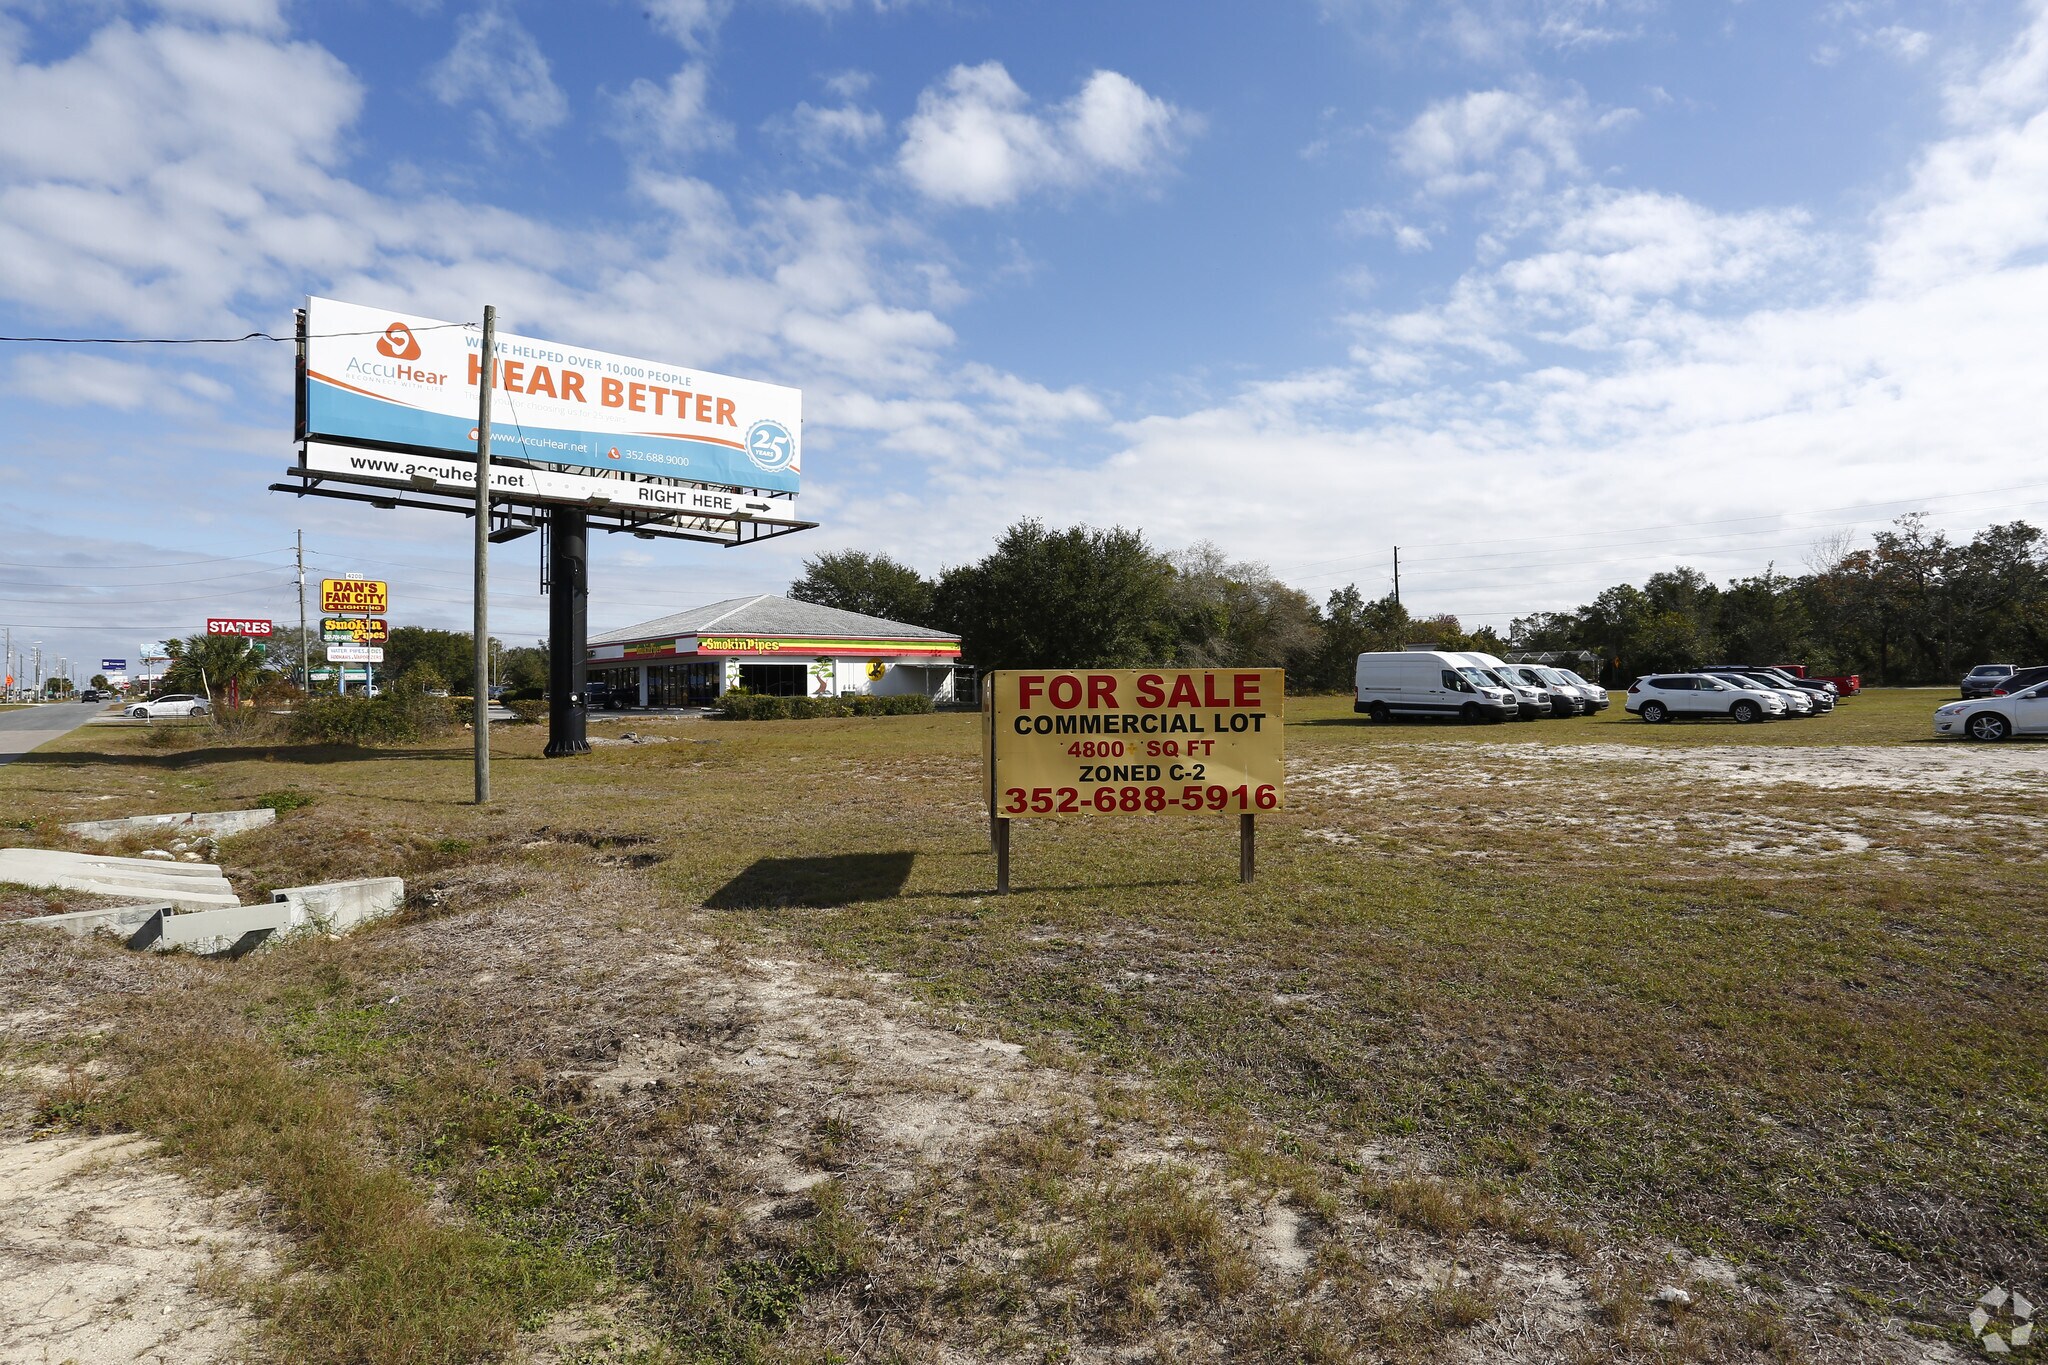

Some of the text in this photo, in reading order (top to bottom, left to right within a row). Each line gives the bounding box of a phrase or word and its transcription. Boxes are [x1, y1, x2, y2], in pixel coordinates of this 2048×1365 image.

[346, 356, 448, 386] AccuHear
[513, 344, 564, 363] HELPED
[568, 355, 602, 371] OVER
[606, 362, 645, 379] 10,000
[648, 370, 692, 387] PEOPLE
[467, 353, 738, 427] HEAR BETTER
[752, 429, 788, 463] 25
[755, 449, 774, 457] YEARS
[625, 448, 690, 467] 352.688.9000
[638, 487, 686, 504] RIGHT
[693, 493, 733, 510] HERE
[333, 581, 378, 593] DAN'S
[325, 592, 385, 604] FAN CITY
[209, 621, 270, 634] STAPLES
[325, 619, 383, 631] Smokin
[353, 629, 386, 641] Pipes
[1018, 673, 1262, 710] FOR SALE
[1014, 712, 1266, 735] COMMERCIAL LOT
[1067, 739, 1215, 758] 4800 SQ FT
[1079, 763, 1206, 782] ZONED C-2
[1005, 784, 1277, 814] 352-688-5916
